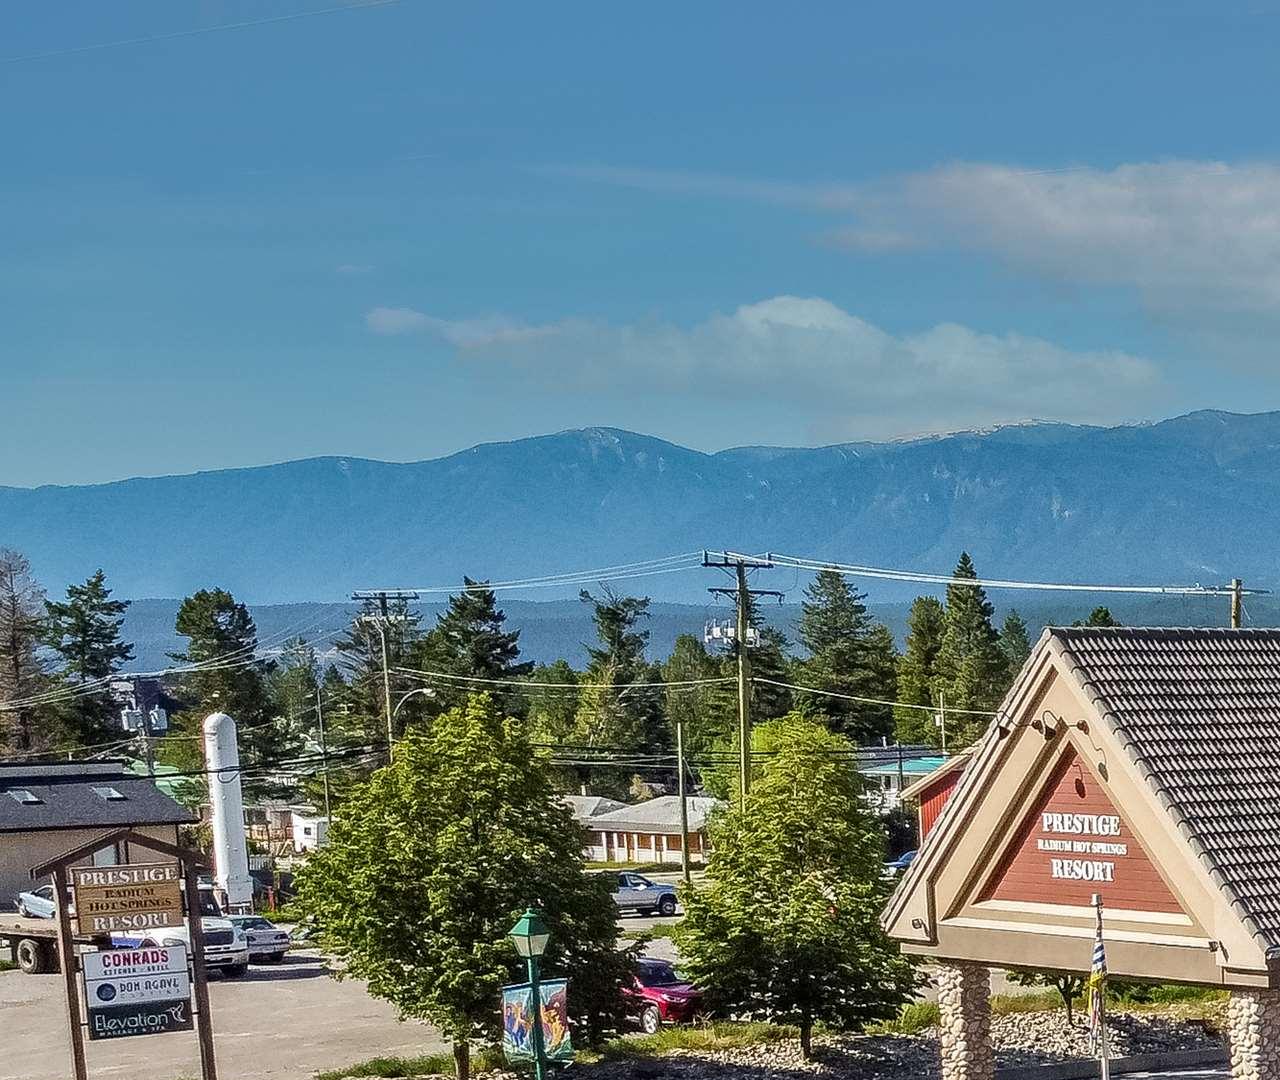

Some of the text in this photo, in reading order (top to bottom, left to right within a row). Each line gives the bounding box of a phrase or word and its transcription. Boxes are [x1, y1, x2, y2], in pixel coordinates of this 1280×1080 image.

[1042, 813, 1121, 836] PRESTIGE
[1037, 839, 1127, 856] RADIUM HOT SPRINGS
[79, 867, 178, 886] PRESTIGE
[1051, 859, 1114, 881] RESORT
[104, 888, 155, 899] RADIUM
[88, 898, 172, 912] HOT SPRINGS
[93, 912, 170, 930] RESORT
[102, 949, 169, 968] CONRAD'S
[120, 982, 140, 993] DON
[95, 1013, 169, 1031] Elevation
